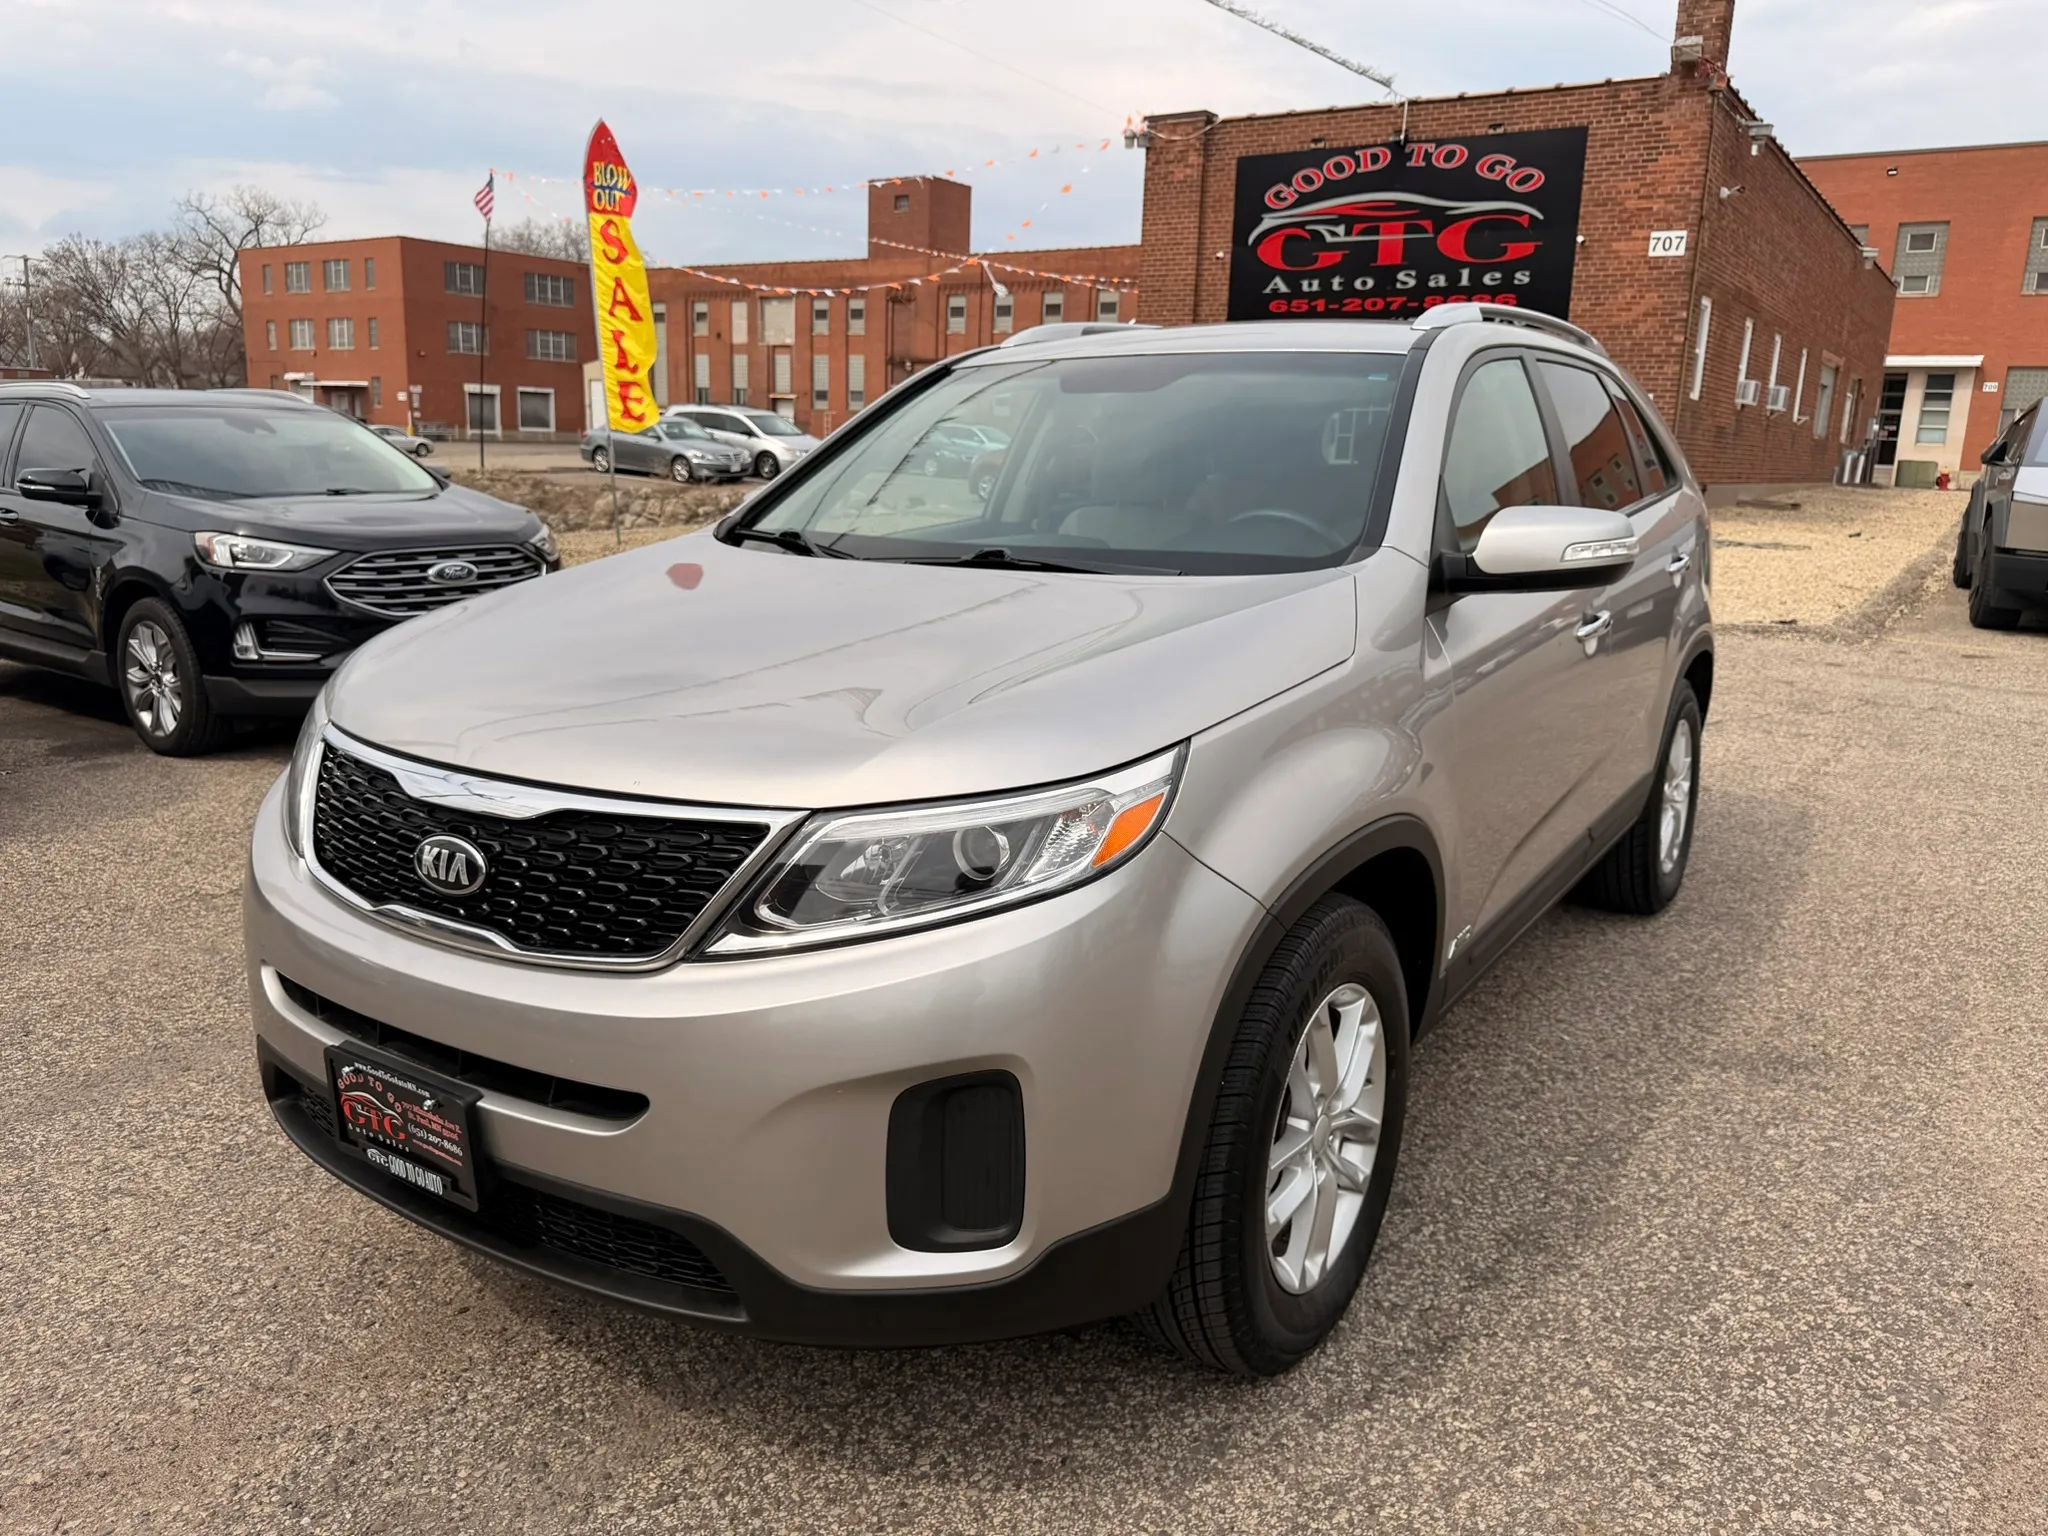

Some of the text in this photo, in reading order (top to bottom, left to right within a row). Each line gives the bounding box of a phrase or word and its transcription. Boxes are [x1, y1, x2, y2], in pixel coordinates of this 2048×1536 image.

[593, 161, 632, 191] BLOW
[1264, 143, 1547, 210] GOOD TO GO
[592, 189, 626, 212] OUT
[1256, 214, 1544, 271] GTG
[1652, 236, 1685, 252] 707
[1262, 267, 1531, 295] Auto Sales
[600, 219, 645, 422] SALE
[422, 844, 470, 886] KIA
[337, 1072, 402, 1113] GOOD TO GO
[348, 1123, 374, 1138] Auto
[378, 1134, 409, 1152] Sales
[407, 1122, 427, 1139] (651)
[428, 1133, 463, 1156] 207-8686
[388, 1155, 406, 1178] GOOD
[406, 1162, 416, 1183] TO
[415, 1166, 426, 1187] GO
[425, 1170, 443, 1195] AUTO
